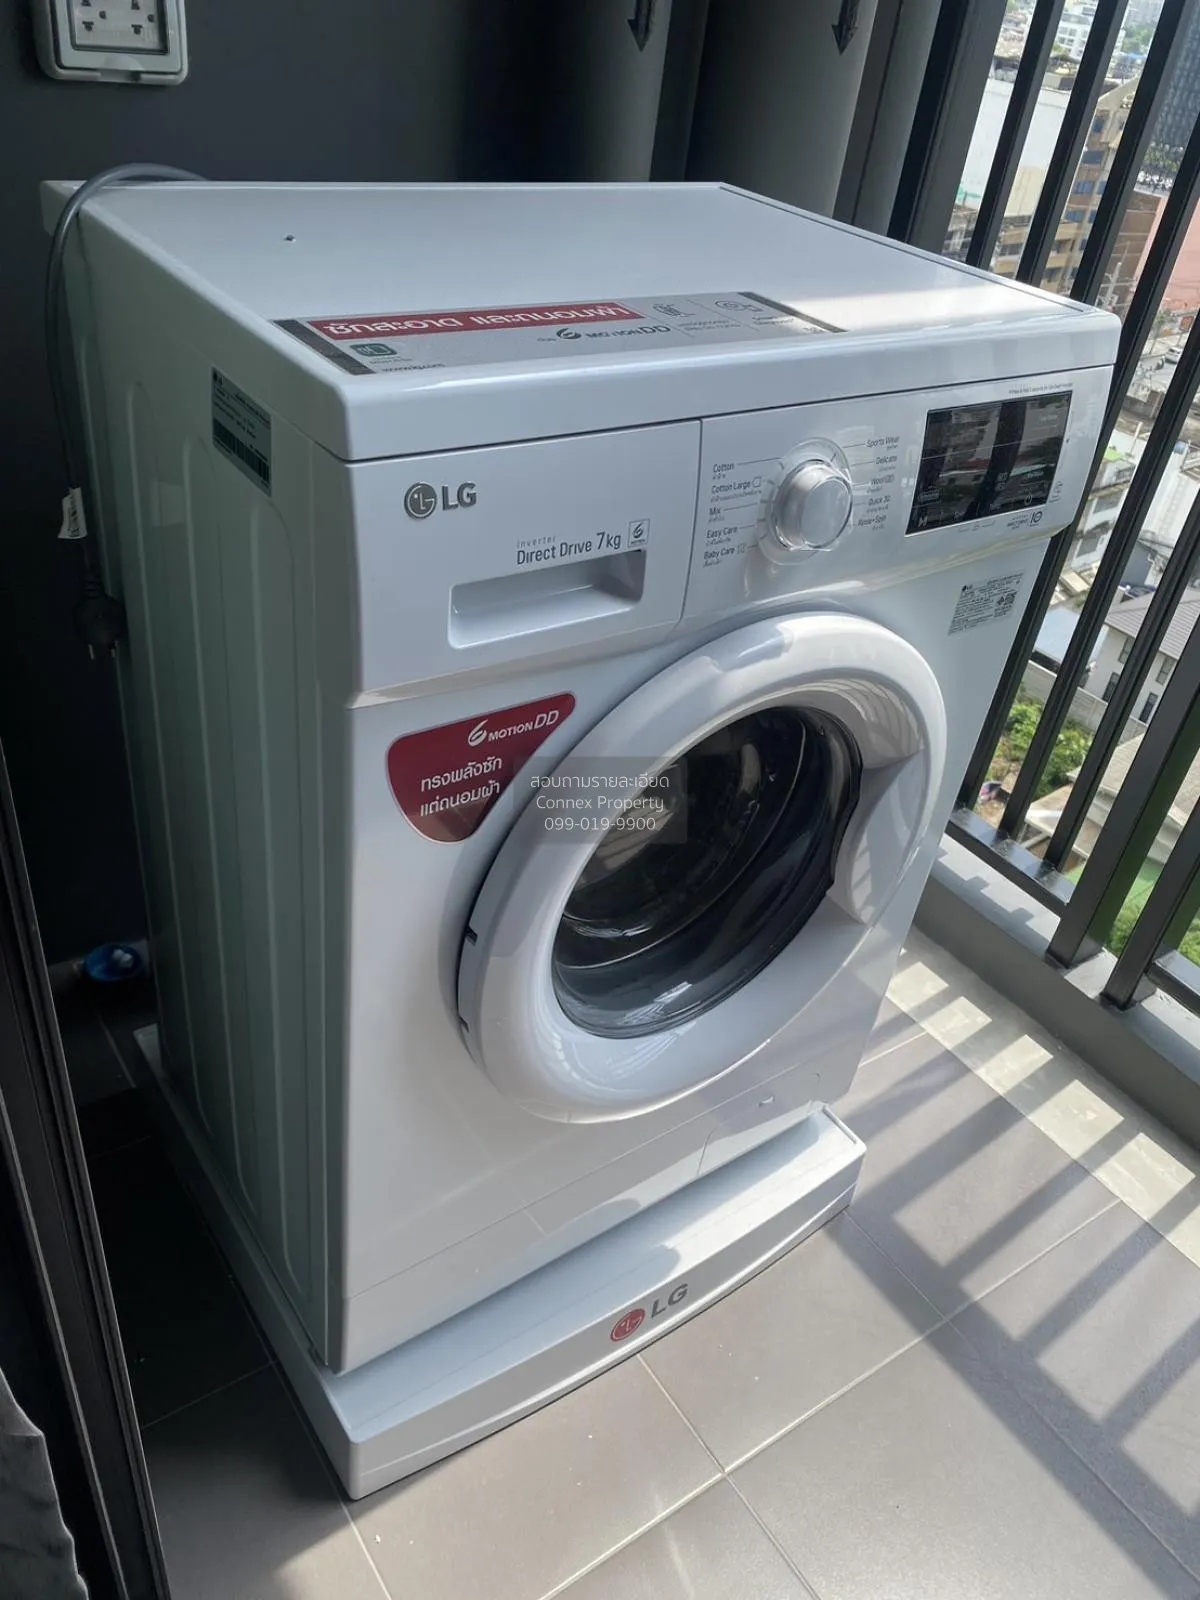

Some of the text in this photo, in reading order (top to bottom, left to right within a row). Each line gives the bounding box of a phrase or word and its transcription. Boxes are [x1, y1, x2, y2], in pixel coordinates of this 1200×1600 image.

[324, 316, 464, 335] ซักสะอาด
[712, 463, 735, 473] Cotton
[441, 482, 478, 511] LG
[711, 480, 751, 494] Cotton Large
[709, 507, 721, 516] Mix
[706, 526, 738, 539] Easy Care
[516, 531, 622, 565] Direct Drive 7kg
[703, 547, 735, 561] Baby Care
[420, 754, 503, 793] ทรงพลังซัก
[419, 780, 501, 817] แต่ถนอมผ้า
[650, 1283, 689, 1318] LG
